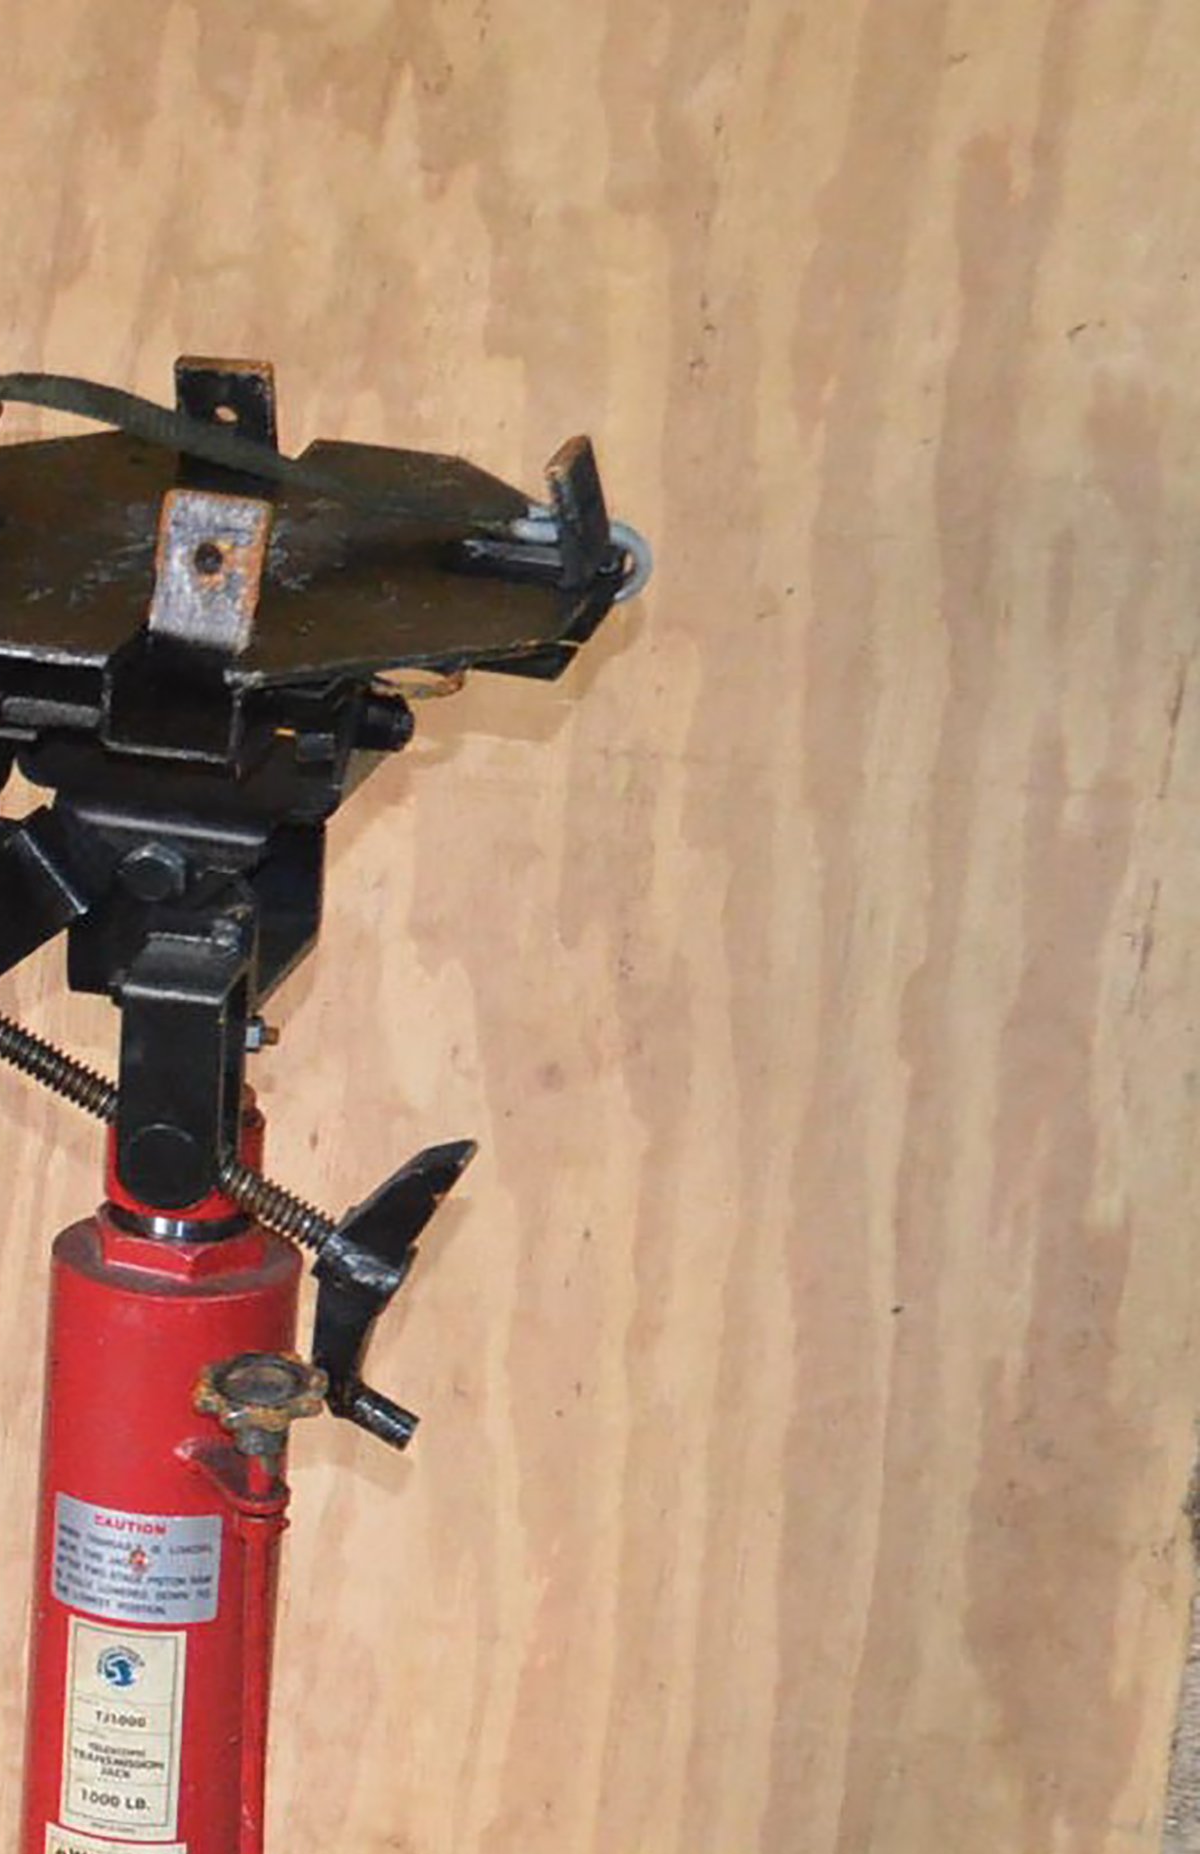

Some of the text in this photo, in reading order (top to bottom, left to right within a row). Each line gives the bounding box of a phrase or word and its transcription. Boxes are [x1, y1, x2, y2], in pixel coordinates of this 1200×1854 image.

[94, 1514, 168, 1535] CAUTION
[73, 1748, 165, 1771] TRANSMISSION
[99, 1766, 131, 1779] JACK
[81, 1788, 121, 1807] 1000
